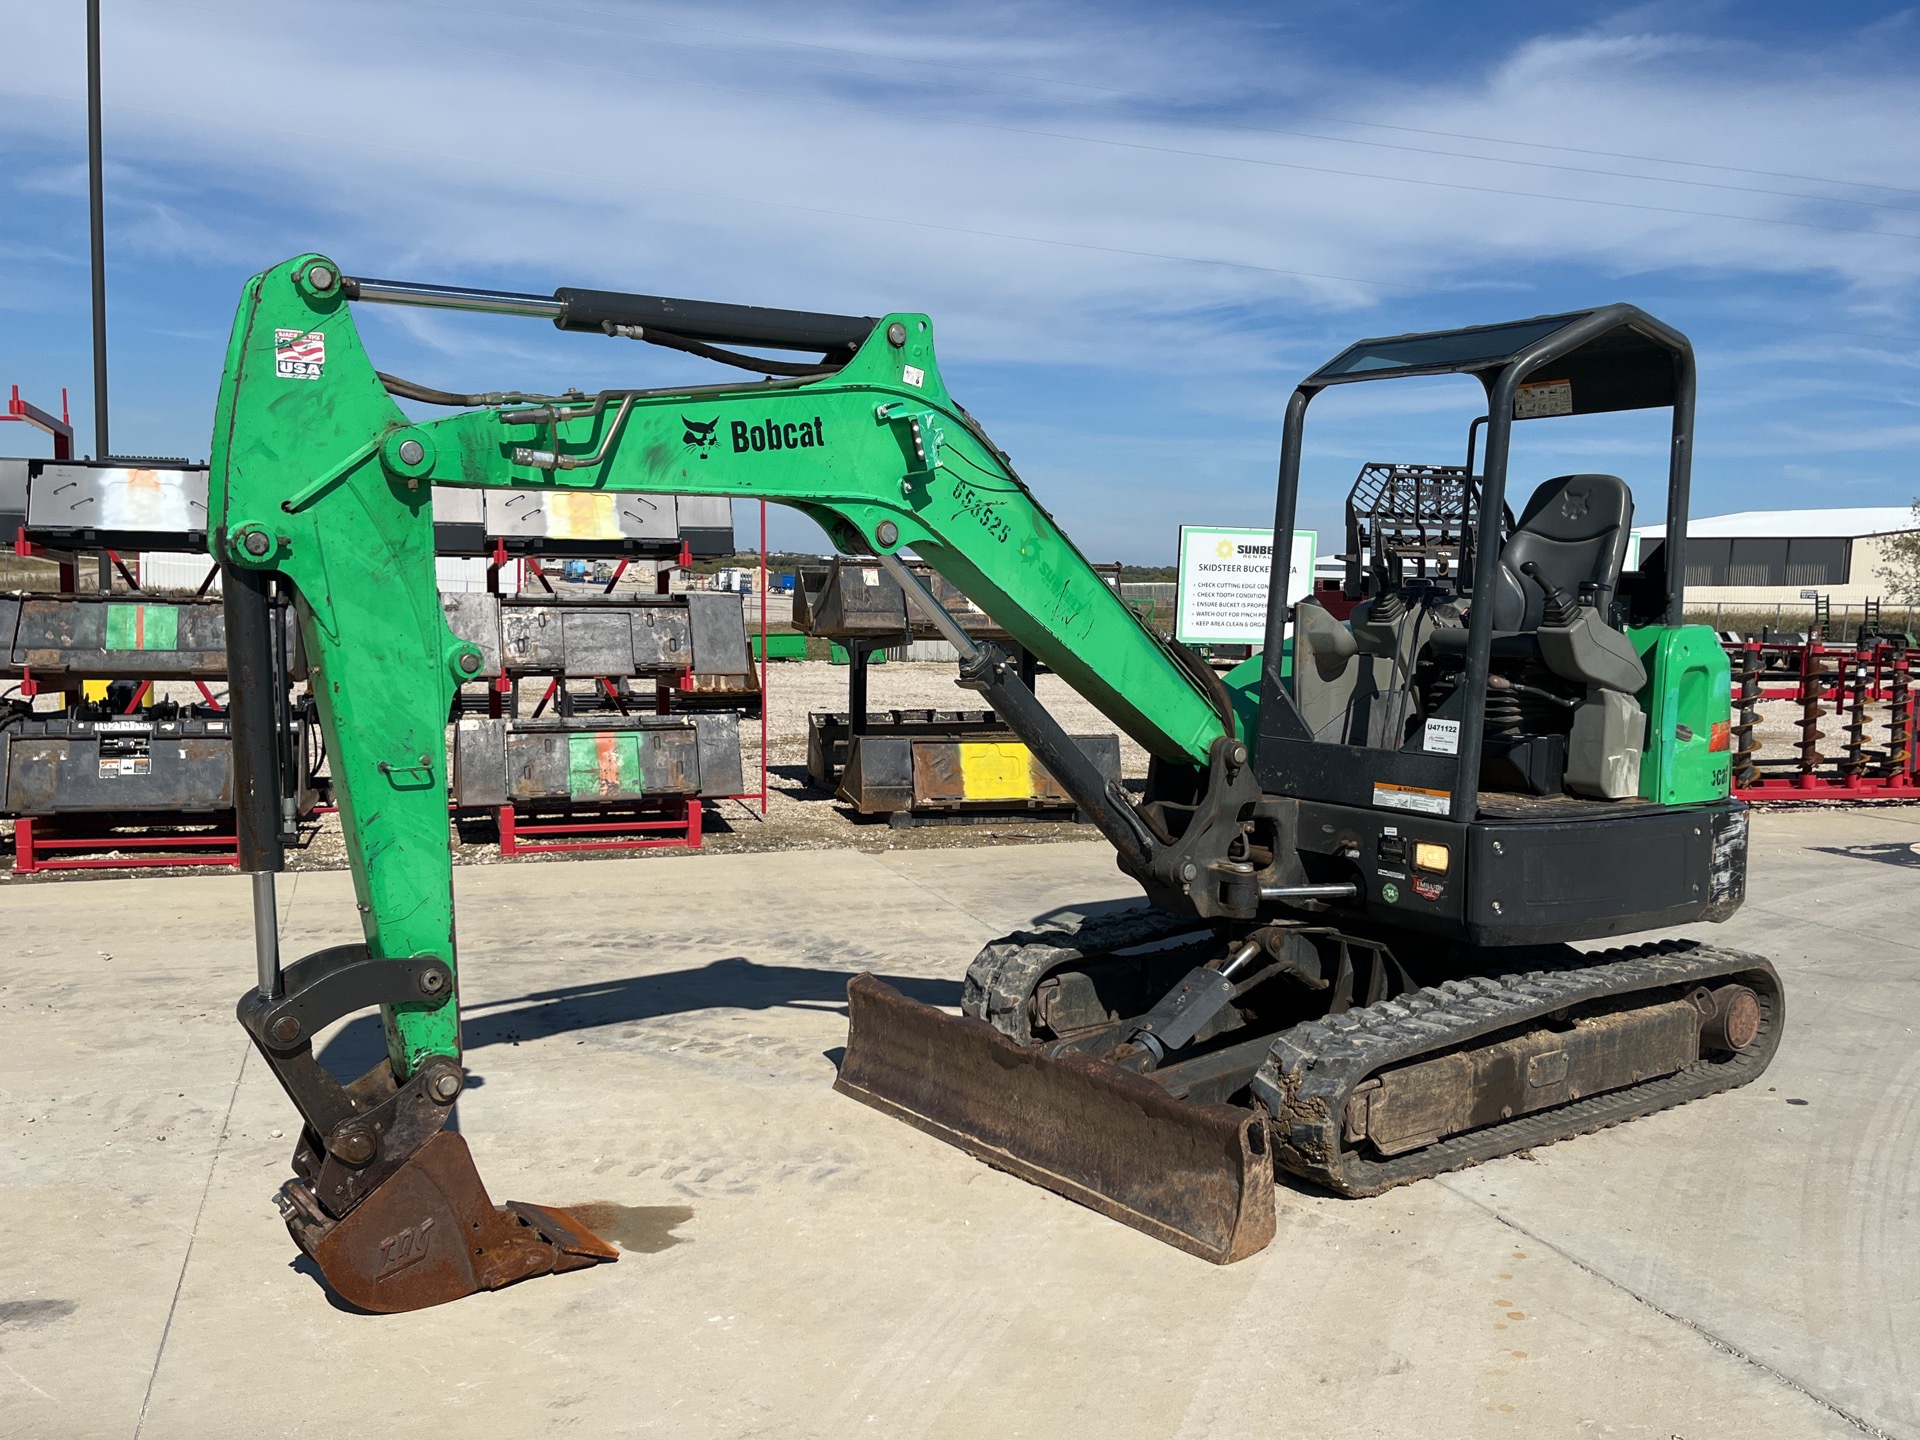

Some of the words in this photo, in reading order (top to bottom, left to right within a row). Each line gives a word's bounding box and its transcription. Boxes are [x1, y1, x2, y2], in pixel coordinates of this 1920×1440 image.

[279, 361, 321, 375] USA
[730, 416, 825, 453] Bobcat
[1237, 545, 1273, 554] SUNBE
[1198, 564, 1242, 572] SKIDSTEER
[1427, 723, 1458, 733] U471122
